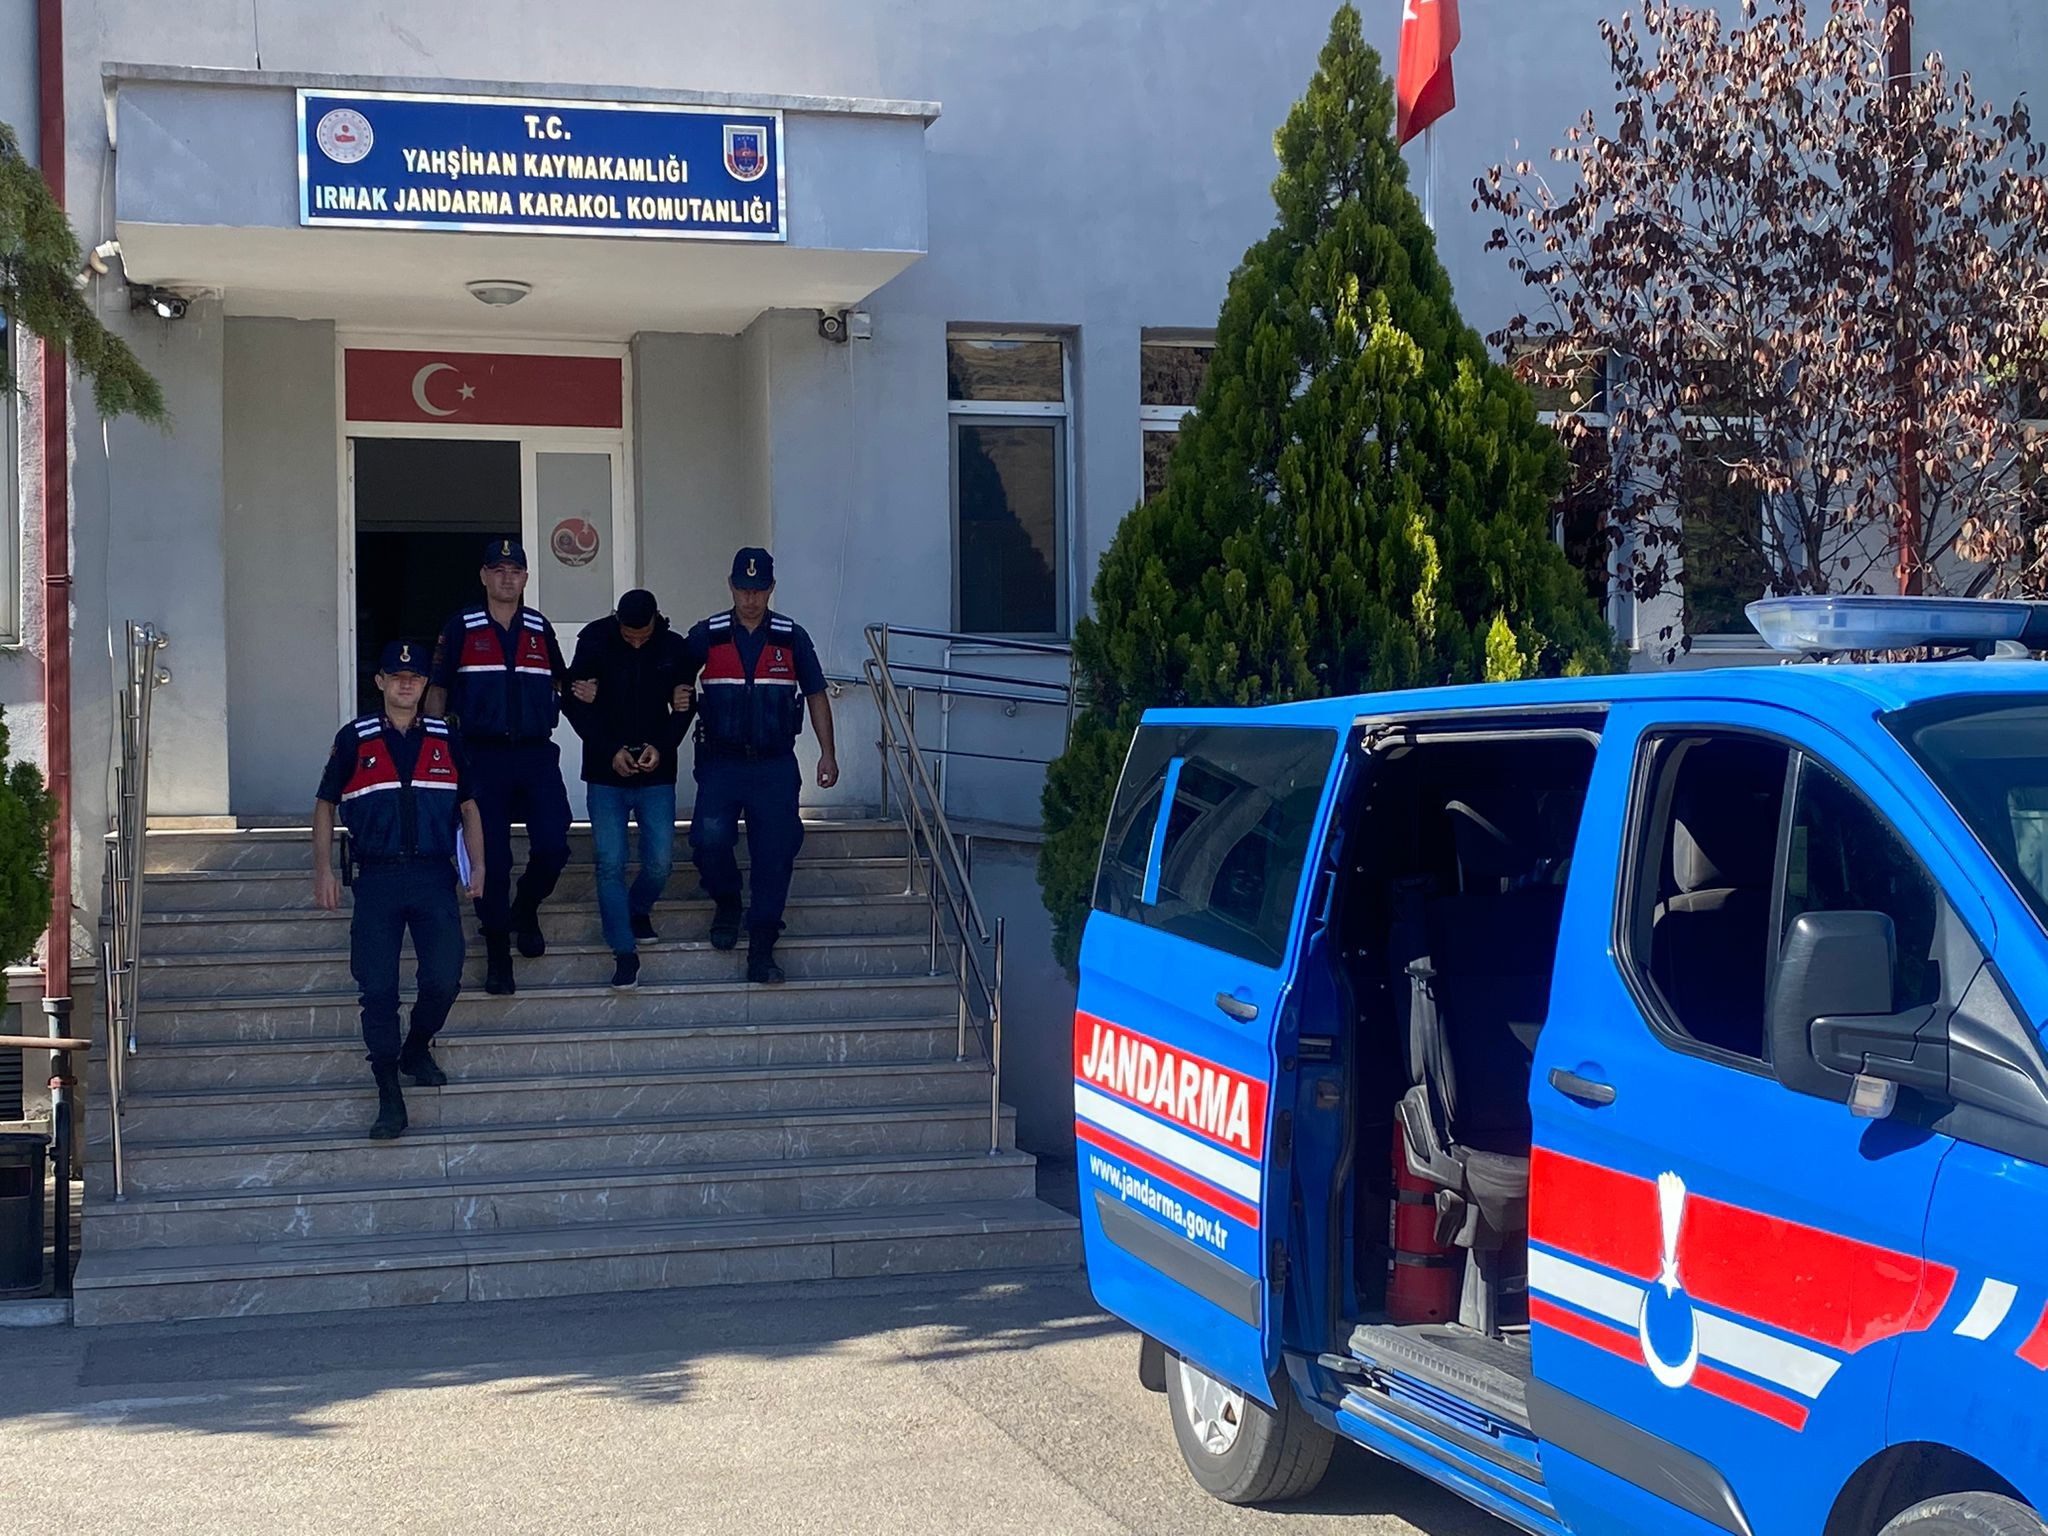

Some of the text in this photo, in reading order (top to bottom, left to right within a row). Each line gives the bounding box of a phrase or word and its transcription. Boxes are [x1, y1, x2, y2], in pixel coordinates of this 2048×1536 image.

[524, 115, 571, 140] T.C.
[402, 145, 688, 183] YAHŞİHAN KAYMAKAMLIĞI
[316, 185, 772, 224] IRMAK JANDARMA KARAKOL KOMUTANLIĞI
[1082, 1023, 1251, 1150] JANDARMA
[1089, 1153, 1229, 1251] www.jandarma.gov.tr
